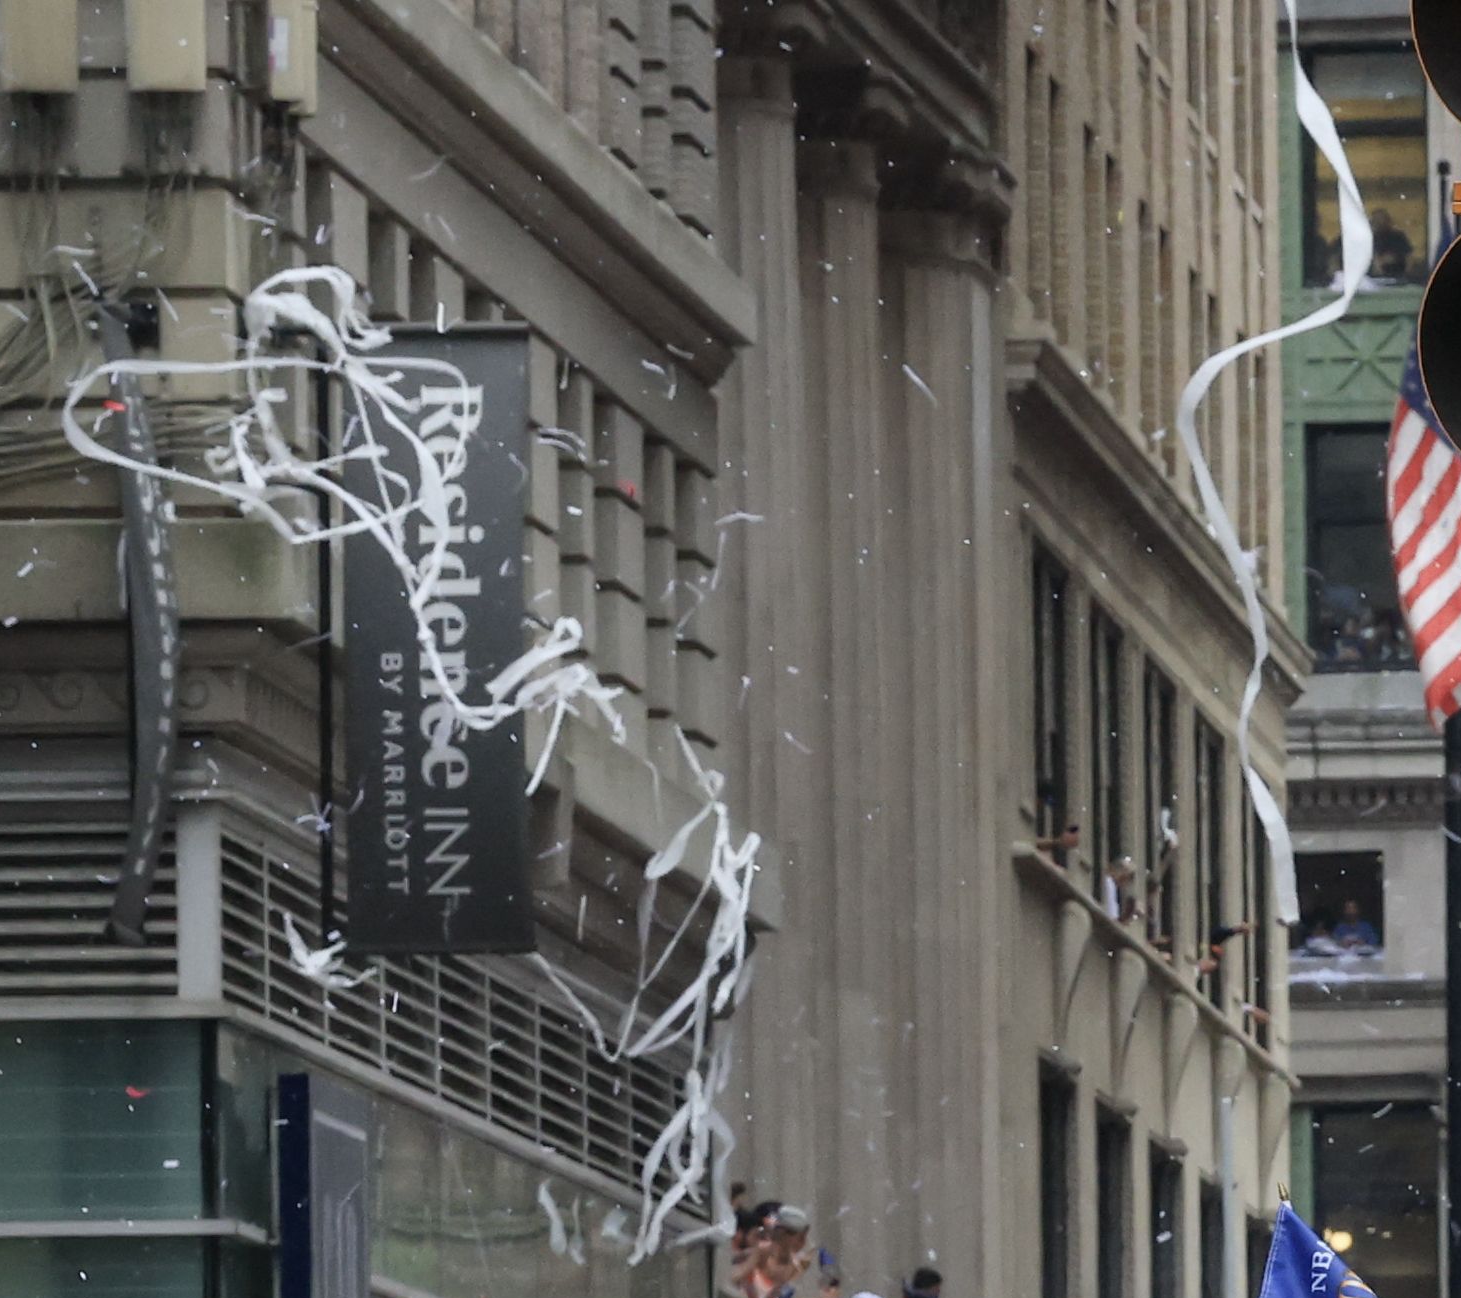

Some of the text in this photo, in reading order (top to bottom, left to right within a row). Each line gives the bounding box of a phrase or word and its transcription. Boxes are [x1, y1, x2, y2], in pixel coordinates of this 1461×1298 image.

[380, 652, 411, 895] BY MARRIOTT
[424, 808, 471, 896] INN
